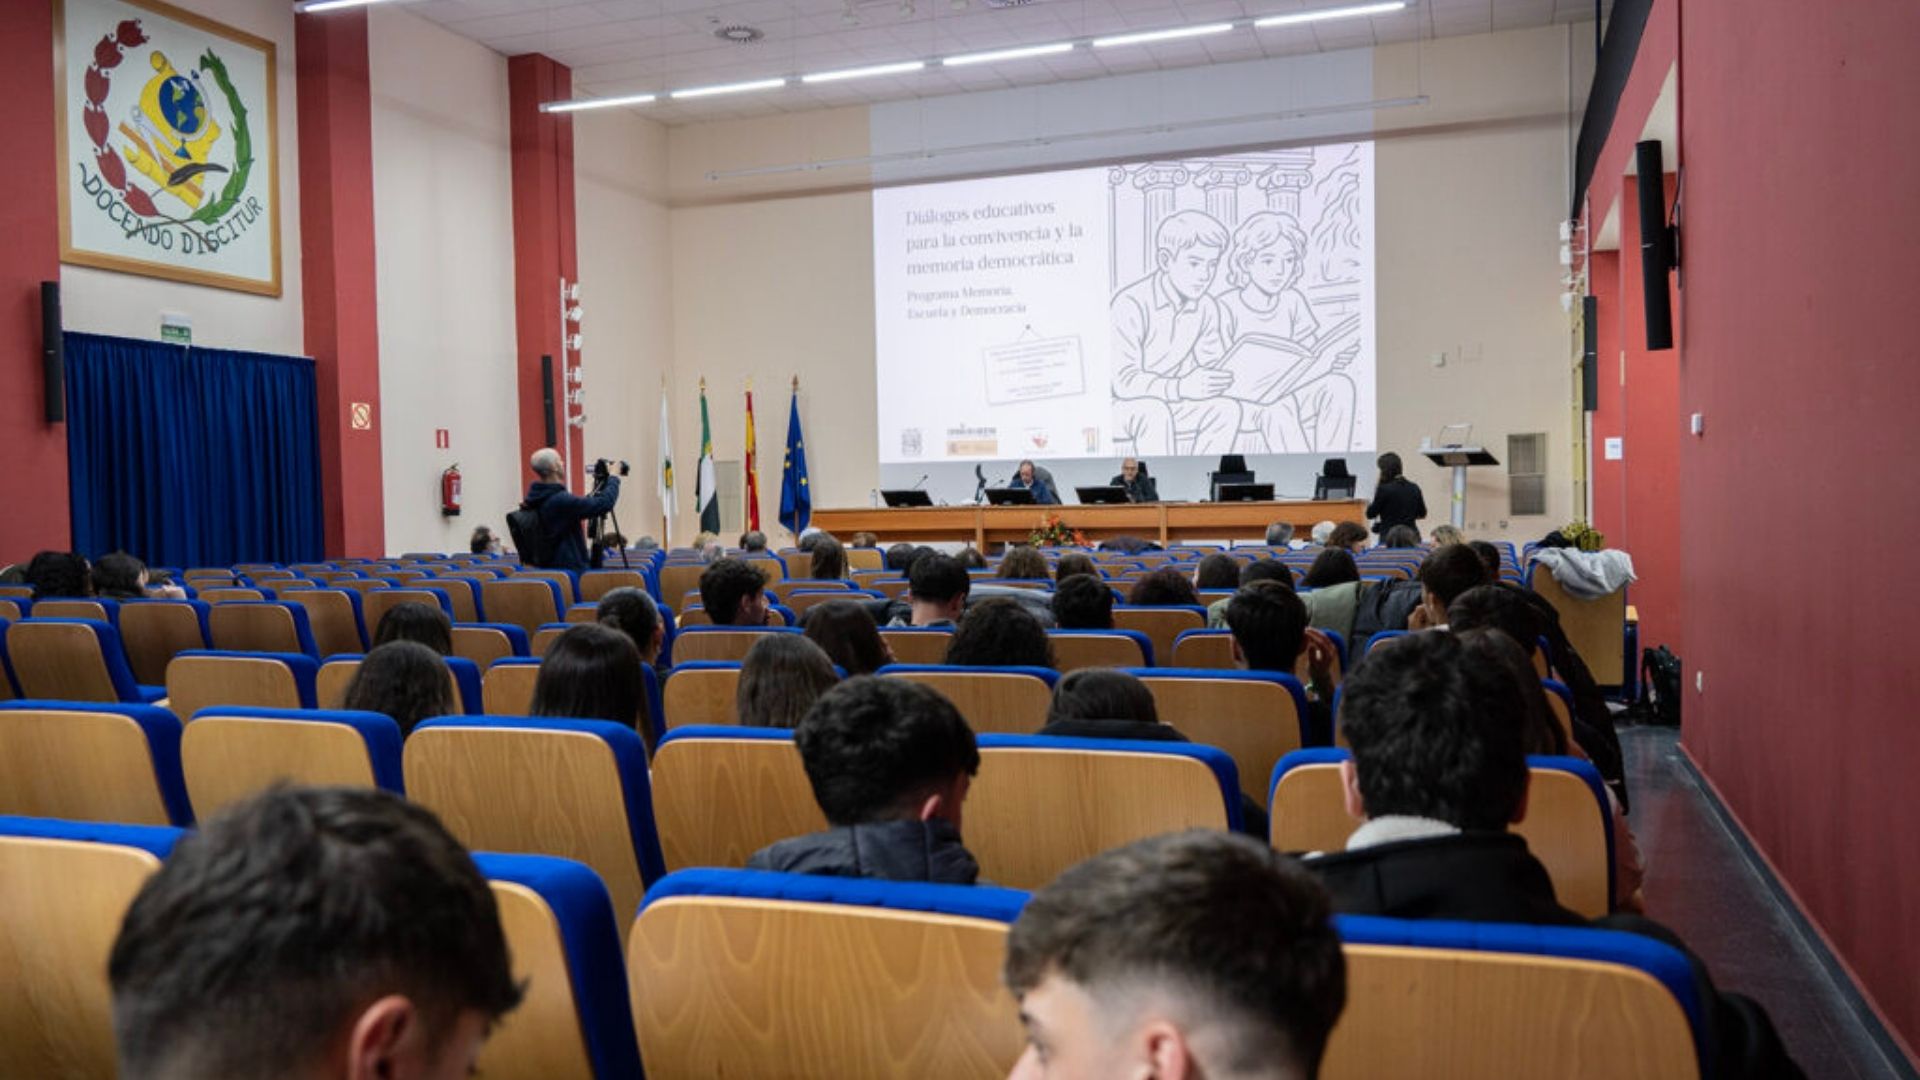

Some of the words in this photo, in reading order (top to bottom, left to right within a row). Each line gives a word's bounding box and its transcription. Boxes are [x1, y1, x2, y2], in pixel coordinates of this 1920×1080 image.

[79, 162, 173, 250] DOCENDO
[181, 196, 263, 254] DISCITUR
[906, 207, 970, 226] Diálogos
[973, 201, 1055, 220] educativos
[906, 238, 939, 254] para
[943, 232, 956, 247] la
[959, 226, 1050, 246] convivencia
[1055, 226, 1065, 243] y
[1069, 221, 1083, 238] la
[906, 257, 974, 275] memoria
[977, 250, 1074, 270] democrática
[907, 288, 960, 304] Programa
[907, 306, 949, 320] Escuela
[960, 302, 1027, 318] Democracia
